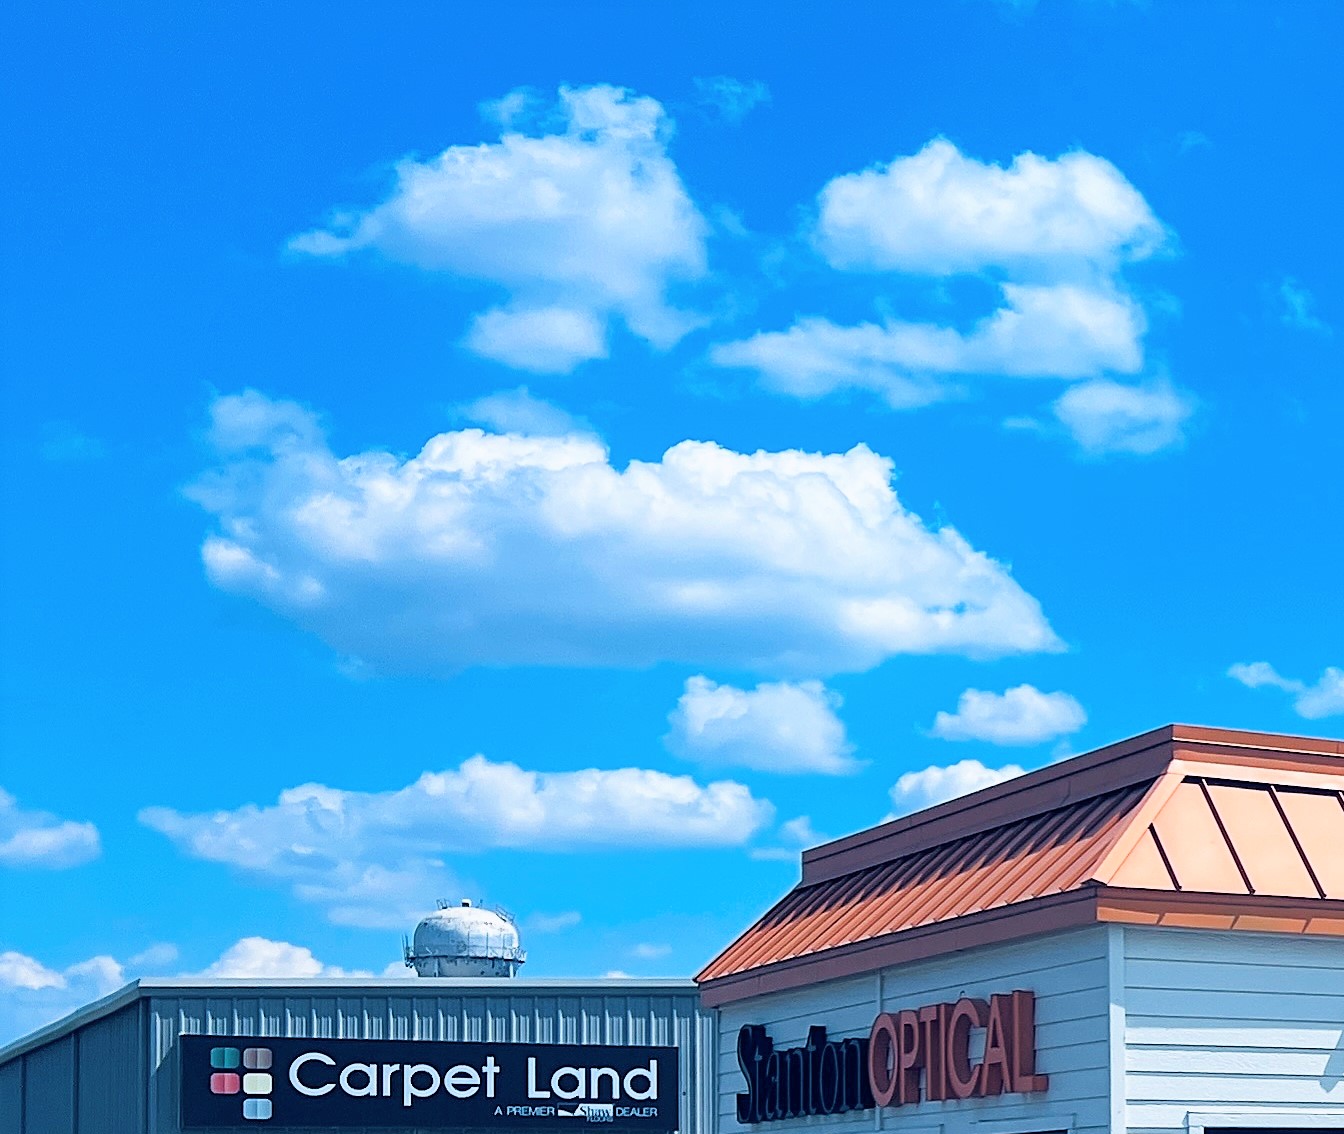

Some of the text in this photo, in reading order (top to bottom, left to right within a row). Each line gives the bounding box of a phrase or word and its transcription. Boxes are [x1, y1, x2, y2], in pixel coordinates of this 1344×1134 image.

[288, 1051, 658, 1107] Carpet Land
[736, 989, 1049, 1124] Stanton OPTICAL
[494, 1106, 503, 1116] A
[506, 1106, 555, 1117] PREMIER
[615, 1106, 658, 1117] DEALER
